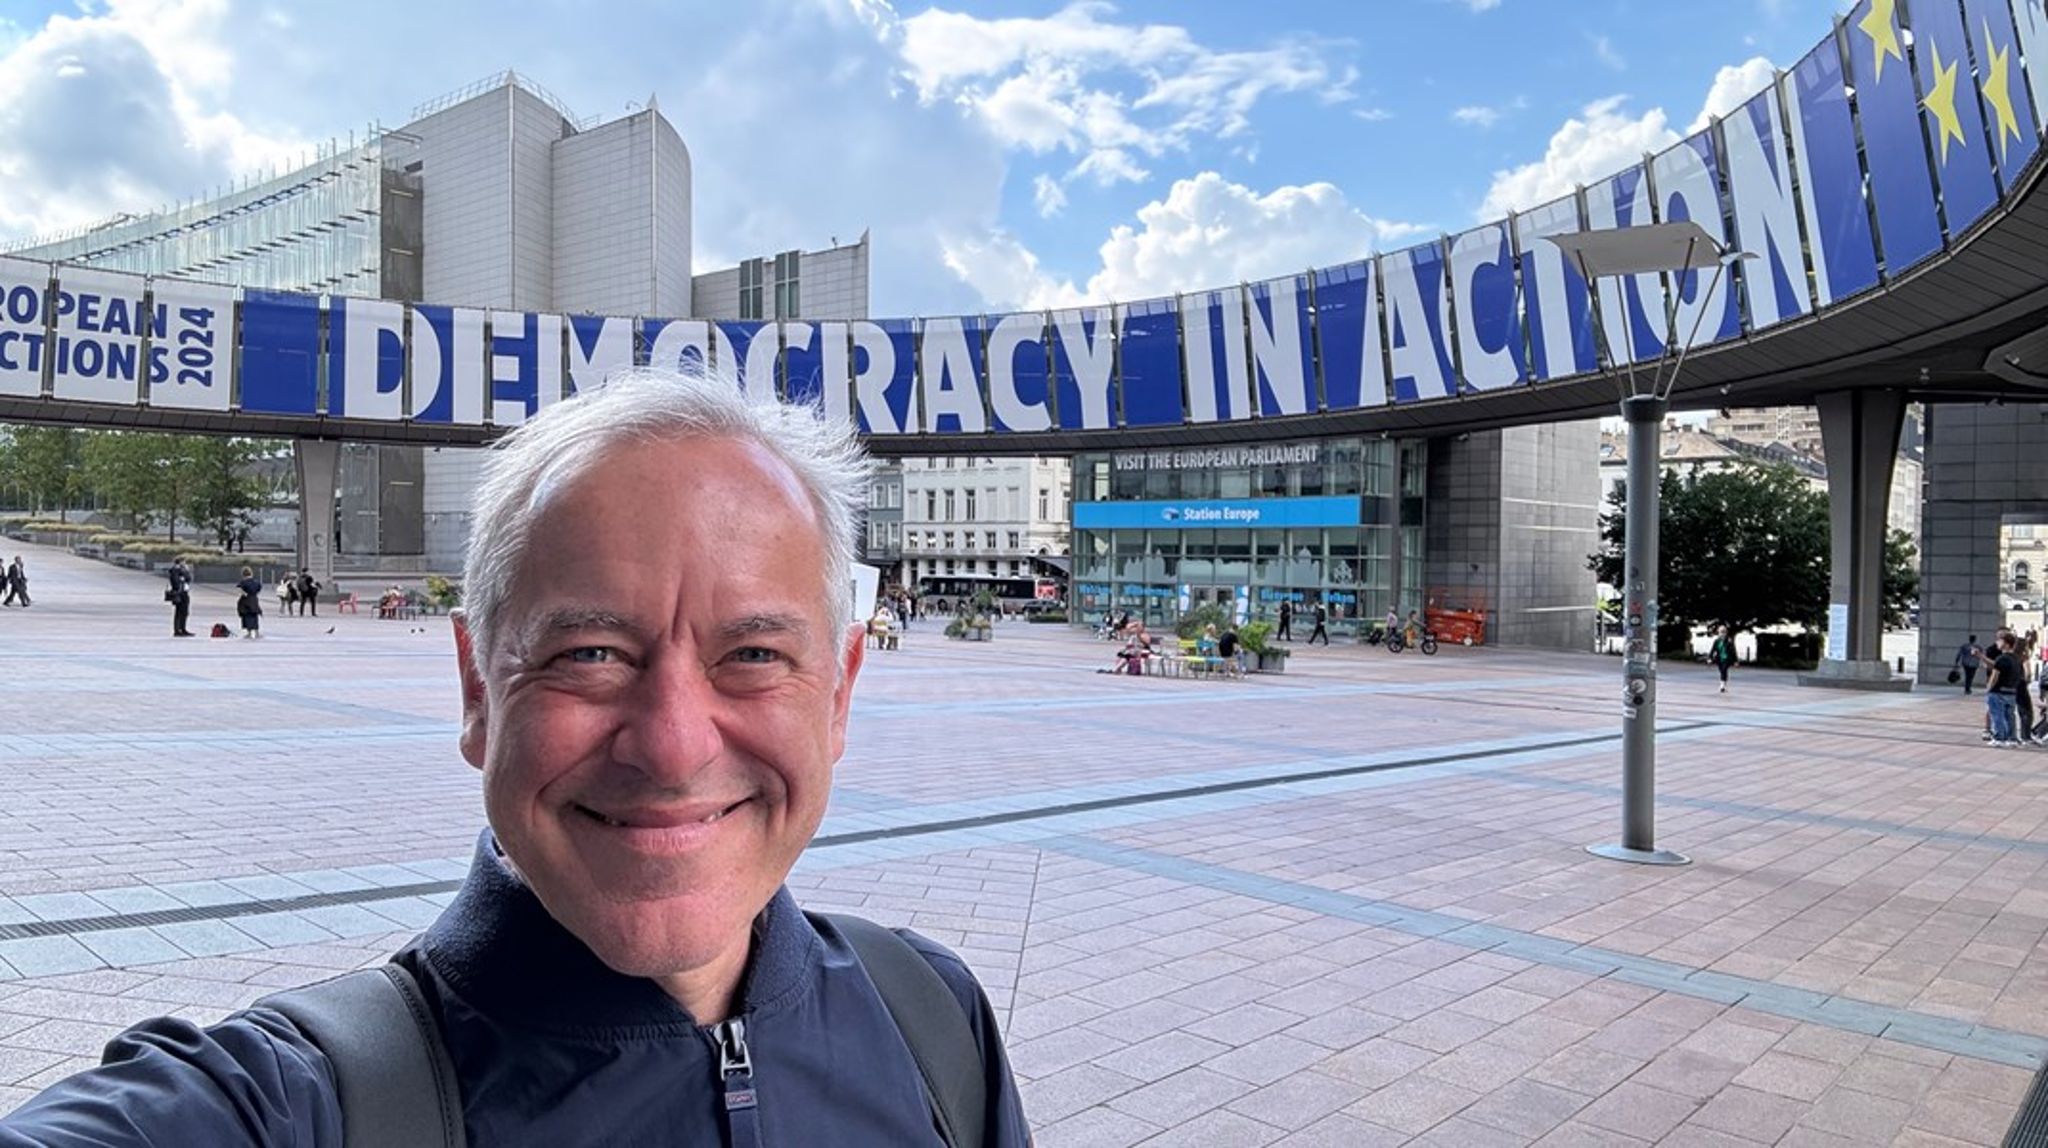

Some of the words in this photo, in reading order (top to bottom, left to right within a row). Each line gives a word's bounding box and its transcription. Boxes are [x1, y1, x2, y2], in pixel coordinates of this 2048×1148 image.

[1180, 277, 1306, 422] IN
[1360, 71, 1831, 406] ACTION
[0, 285, 167, 339] OPEAN
[177, 307, 215, 387] 2024
[1115, 454, 1146, 471] VISIT
[1149, 453, 1171, 470] THE
[1173, 449, 1237, 469] EUROPEAN
[1240, 445, 1318, 465] PARLIAMENT
[1184, 507, 1222, 521] Station
[1224, 507, 1260, 525] Europe
